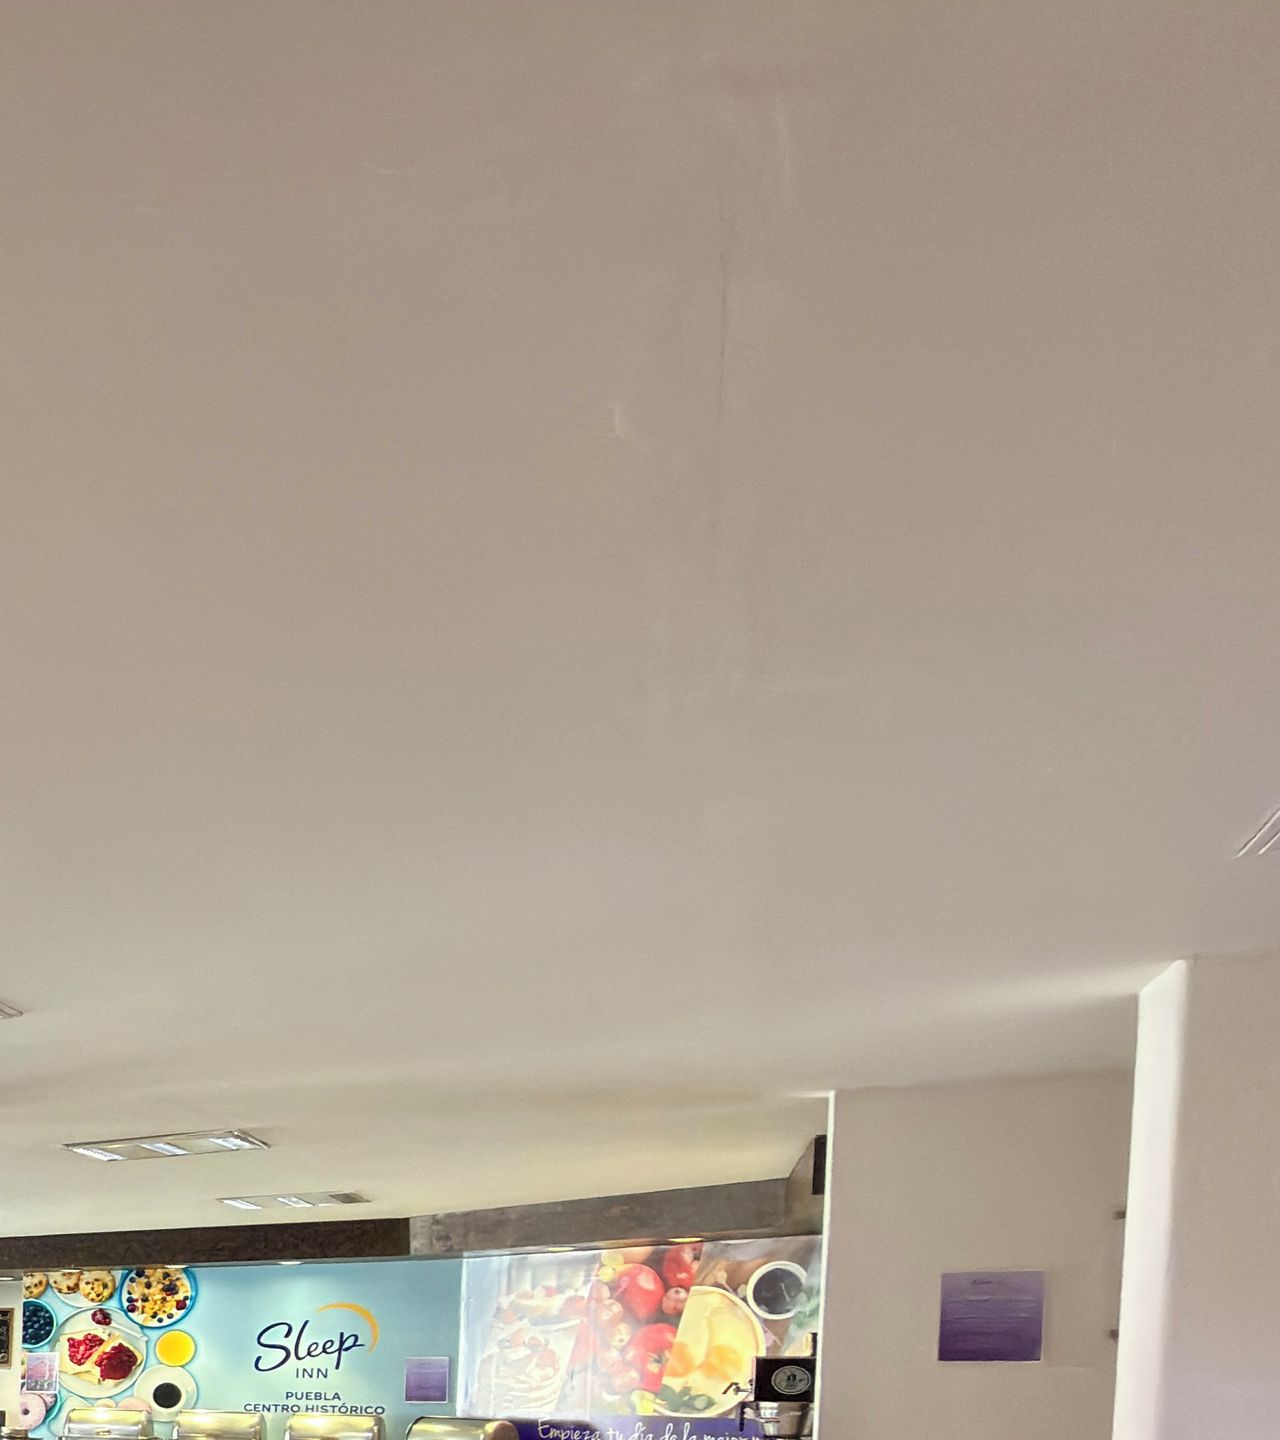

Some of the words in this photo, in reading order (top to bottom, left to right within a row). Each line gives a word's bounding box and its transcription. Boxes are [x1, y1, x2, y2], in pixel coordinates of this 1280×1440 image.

[254, 1319, 366, 1372] Sleep
[295, 1367, 329, 1379] INN
[285, 1391, 342, 1401] PUEBLA
[243, 1403, 301, 1413] CENTRO
[305, 1402, 386, 1415] HISTÓRICO
